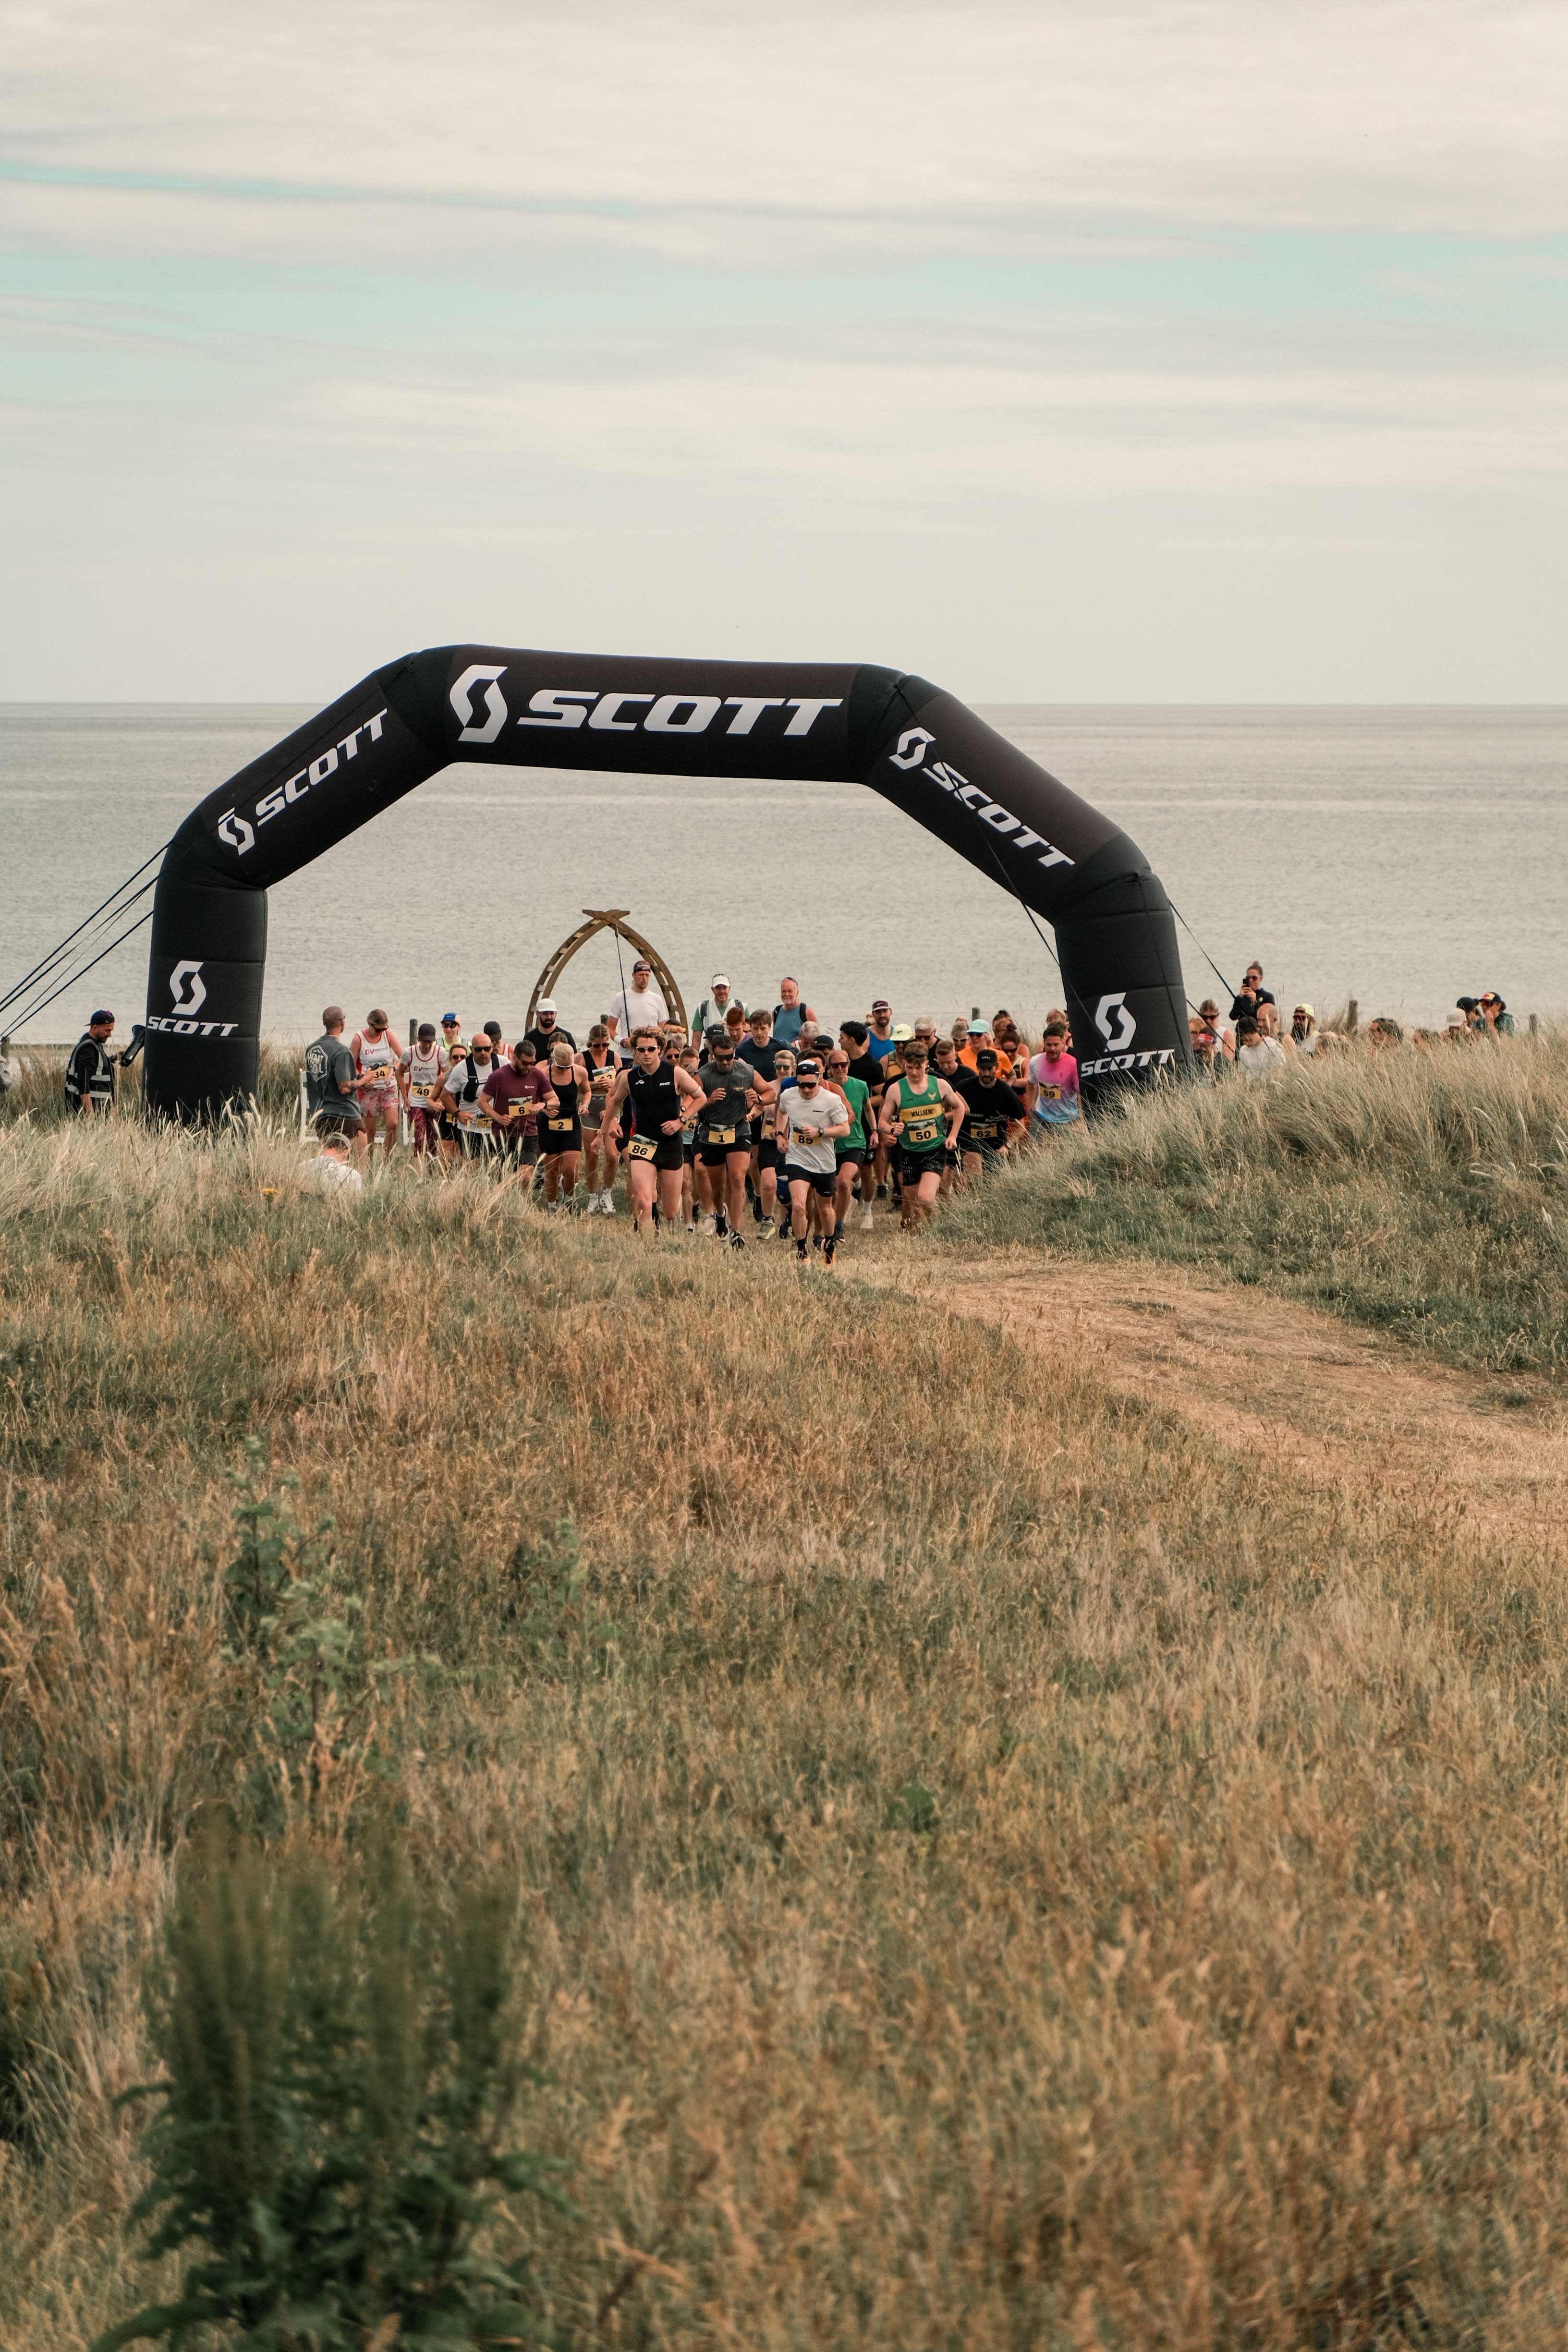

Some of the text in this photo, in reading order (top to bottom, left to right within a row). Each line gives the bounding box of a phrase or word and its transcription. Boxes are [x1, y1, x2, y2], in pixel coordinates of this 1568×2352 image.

[517, 690, 844, 735] SCOTT
[256, 708, 387, 826] SCOTT
[923, 763, 1075, 867] SCOTT
[147, 1016, 239, 1036] SCOTT
[307, 1050, 324, 1066] HEART
[1081, 1049, 1175, 1078] SCOTT
[374, 1070, 386, 1079] 34
[417, 1088, 429, 1096] 49
[1044, 1090, 1055, 1098] 69
[518, 1106, 525, 1115] 6
[911, 1108, 934, 1117] WALLSEND
[718, 1135, 725, 1143] 1
[798, 1135, 814, 1144] 85
[916, 1130, 931, 1140] 50
[632, 1144, 648, 1155] 86
